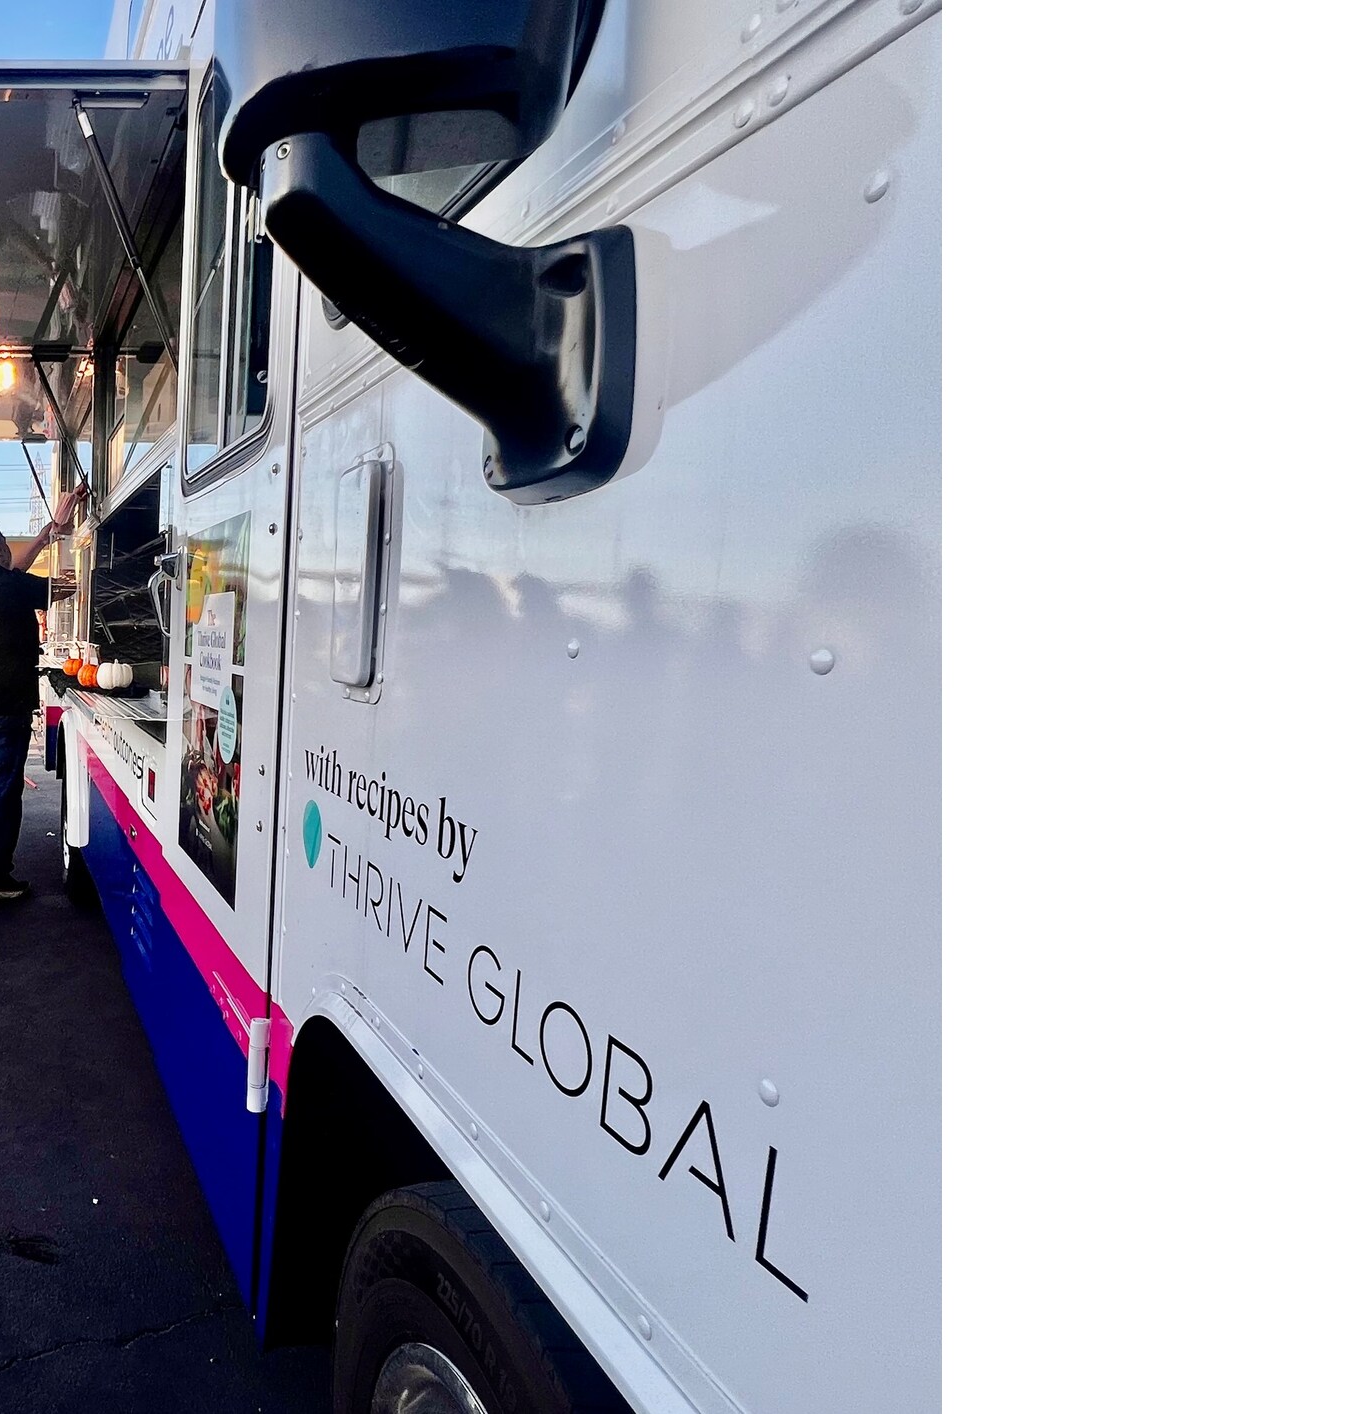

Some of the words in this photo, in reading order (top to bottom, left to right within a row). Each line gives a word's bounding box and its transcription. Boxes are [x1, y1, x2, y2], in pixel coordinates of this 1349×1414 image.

[199, 651, 222, 671] Cookbook
[304, 745, 342, 798] with
[346, 771, 429, 845] recipes
[437, 797, 478, 883] by
[327, 833, 448, 986] THRIVE
[467, 944, 809, 1303] GLOBAL
